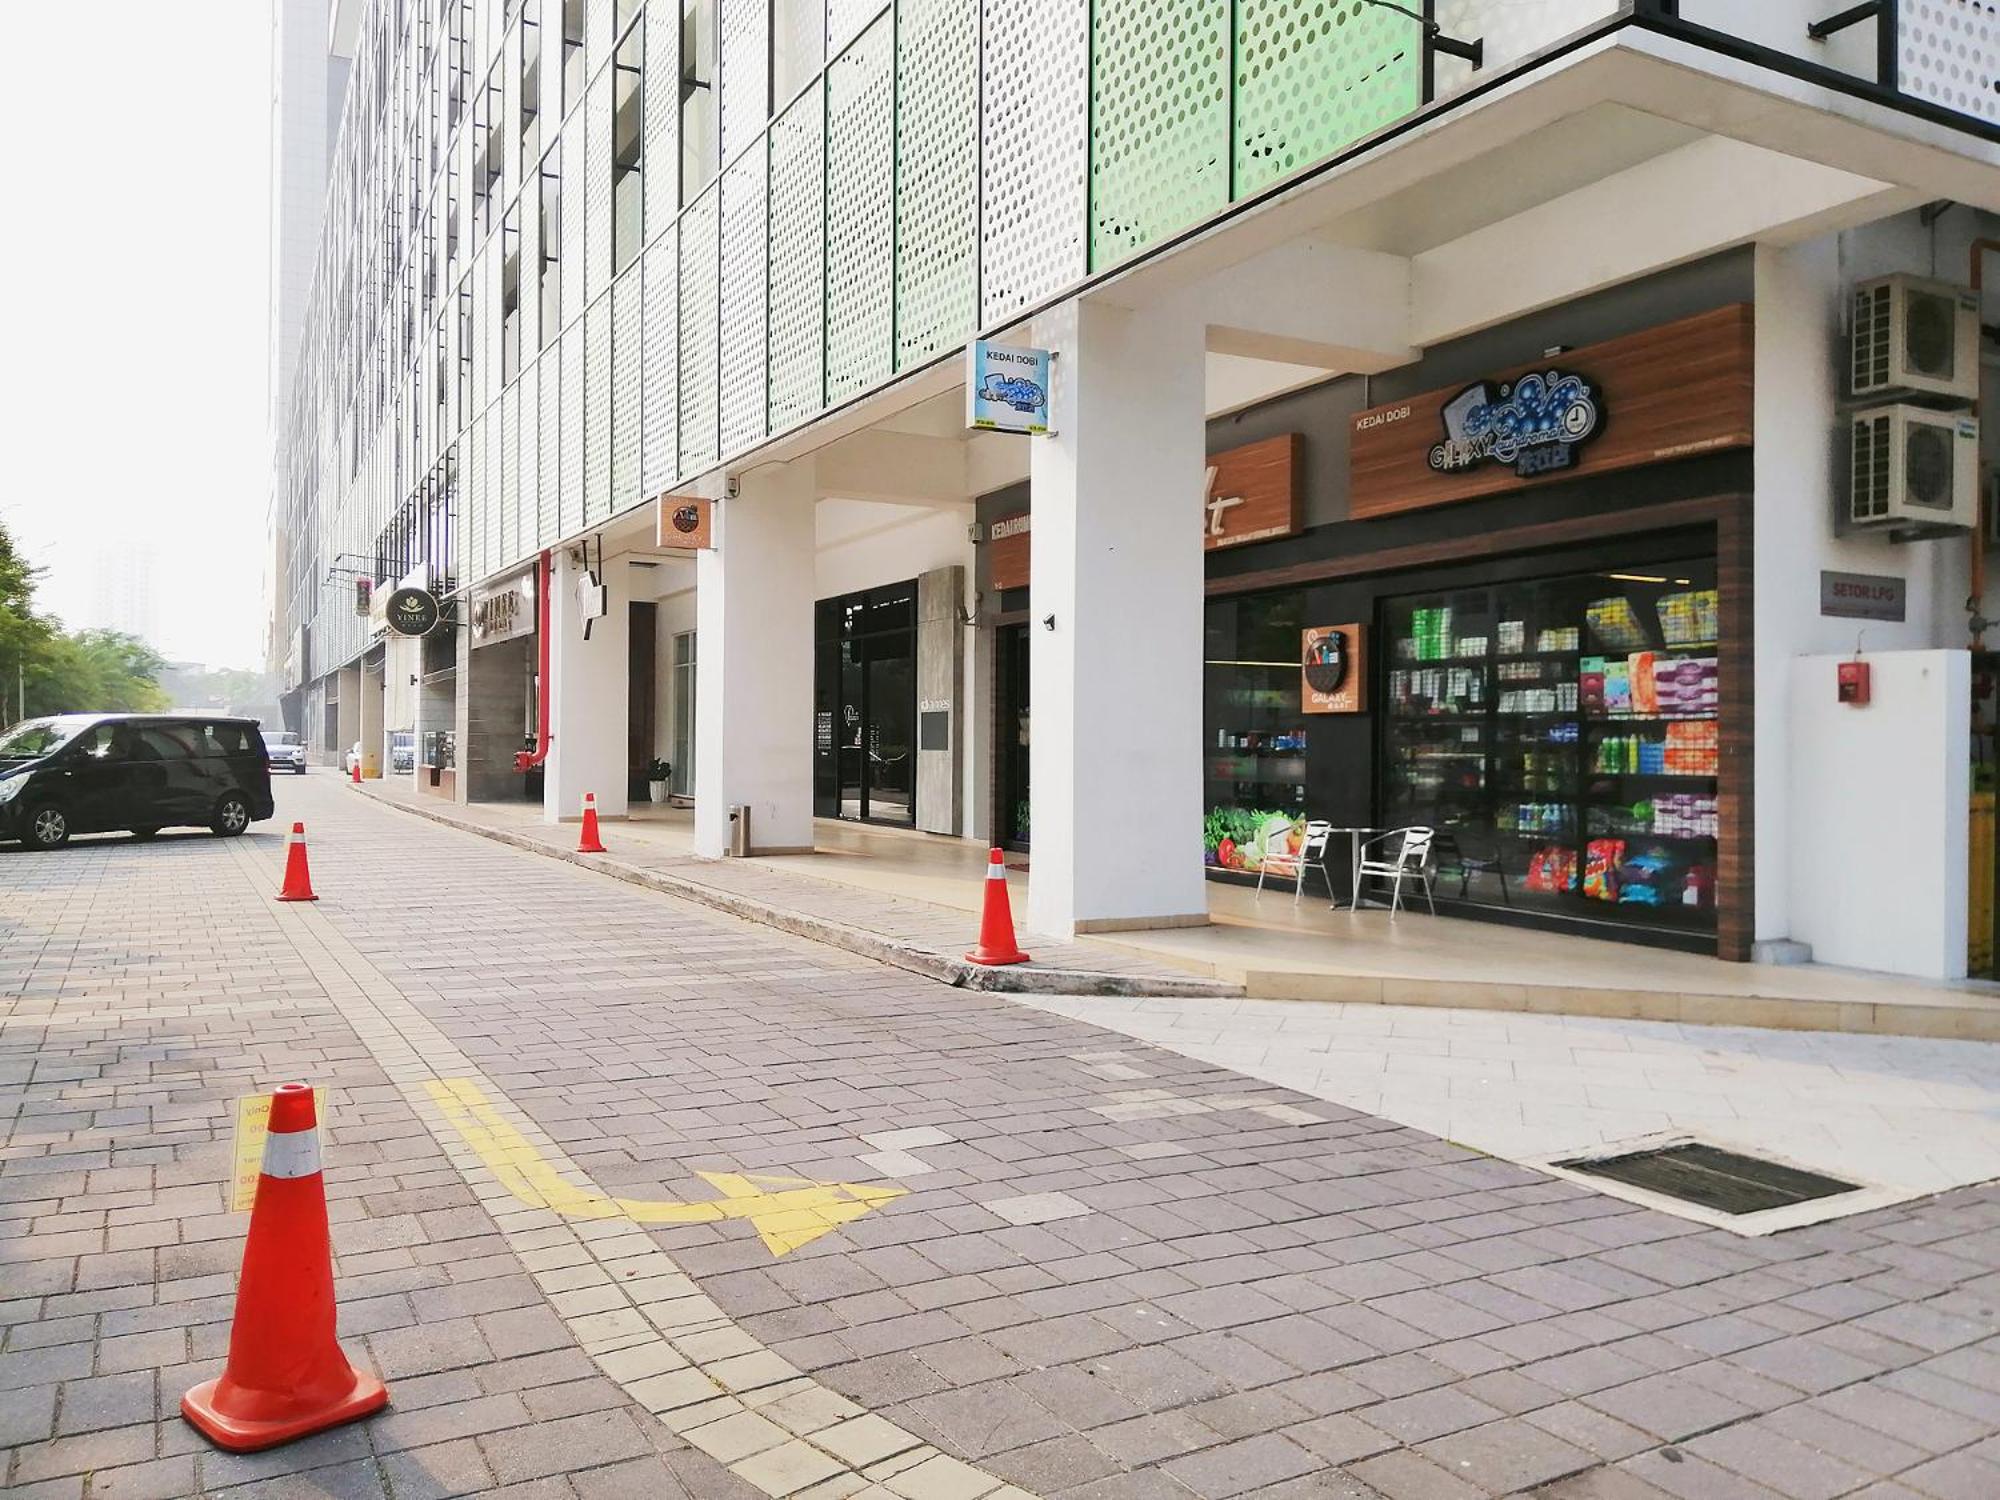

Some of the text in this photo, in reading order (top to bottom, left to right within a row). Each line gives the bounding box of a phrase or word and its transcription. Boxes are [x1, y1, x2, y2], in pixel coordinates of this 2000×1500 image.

[986, 351, 1038, 366] KEDAI DOBI
[1356, 405, 1410, 430] KEDAI DOBI
[1430, 434, 1492, 470] GALAXY
[1833, 582, 1895, 602] SETOR LPG
[1311, 692, 1346, 703] GALAXY
